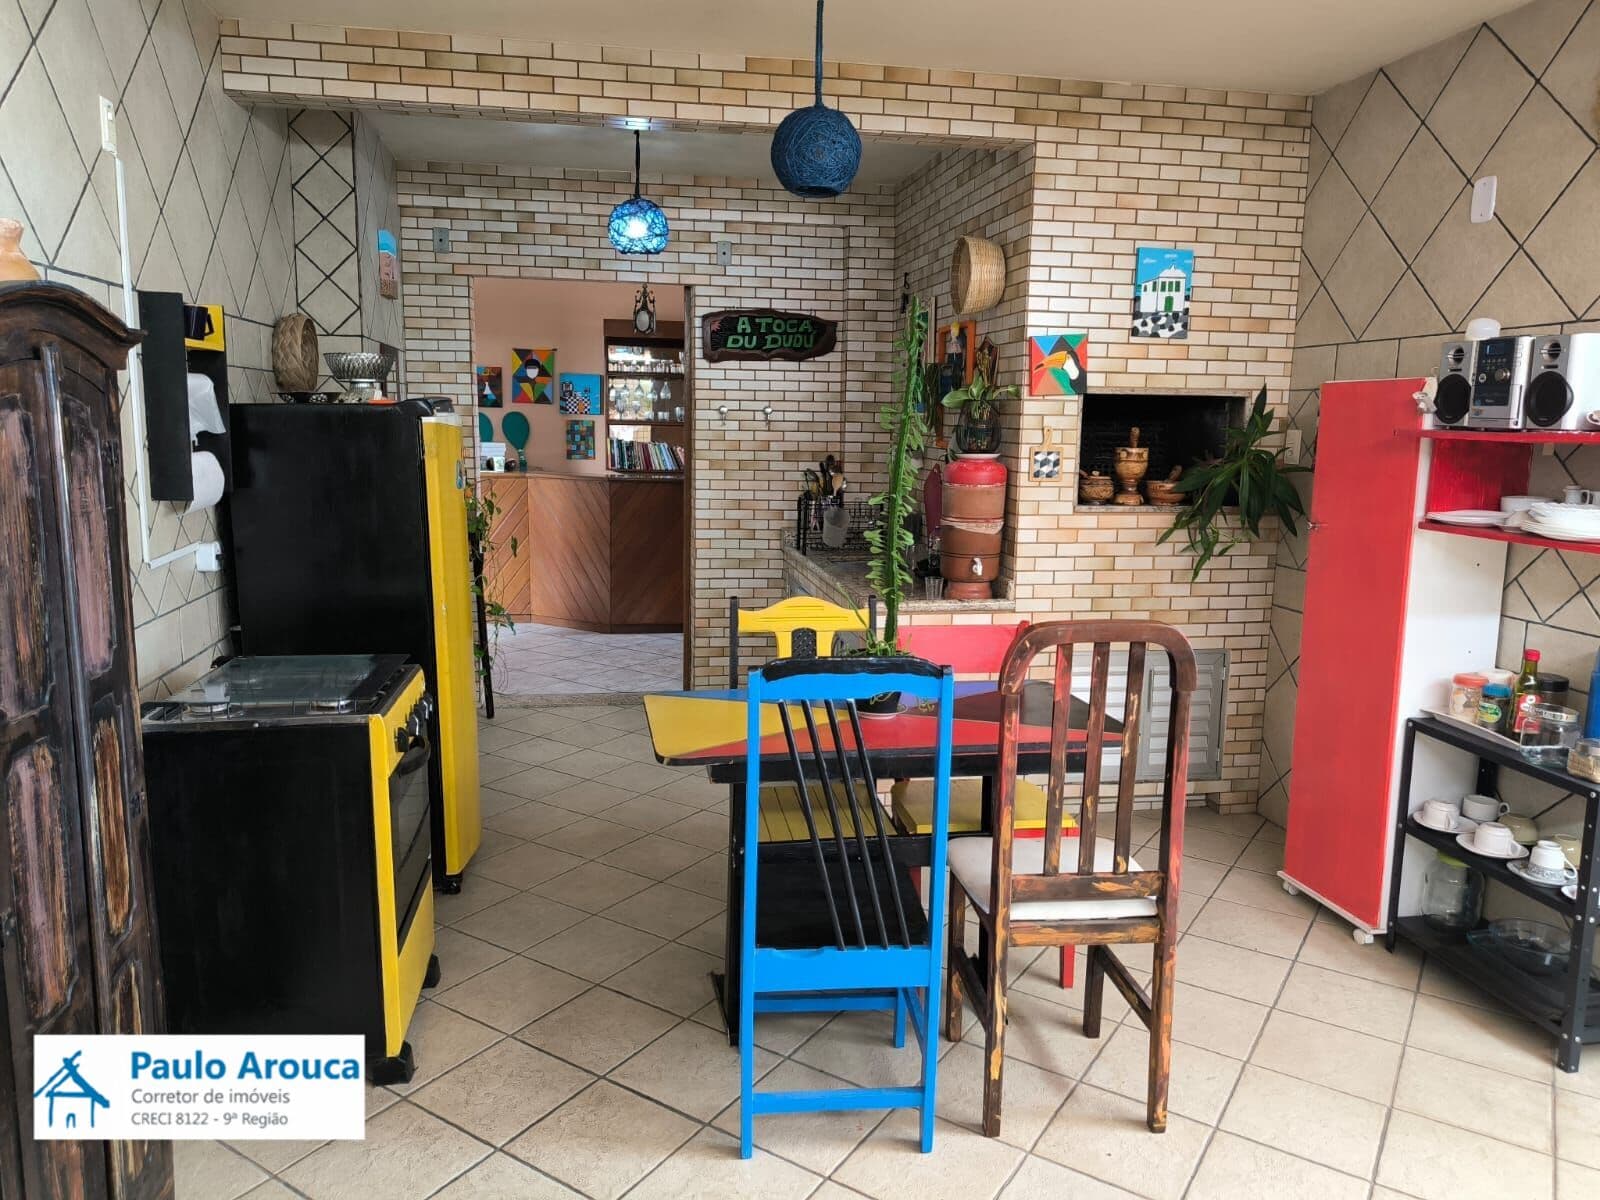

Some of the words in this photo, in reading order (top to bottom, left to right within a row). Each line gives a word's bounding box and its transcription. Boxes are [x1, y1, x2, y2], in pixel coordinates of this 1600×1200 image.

[737, 316, 752, 333] A
[755, 317, 813, 333] TOCA
[726, 335, 757, 348] DU
